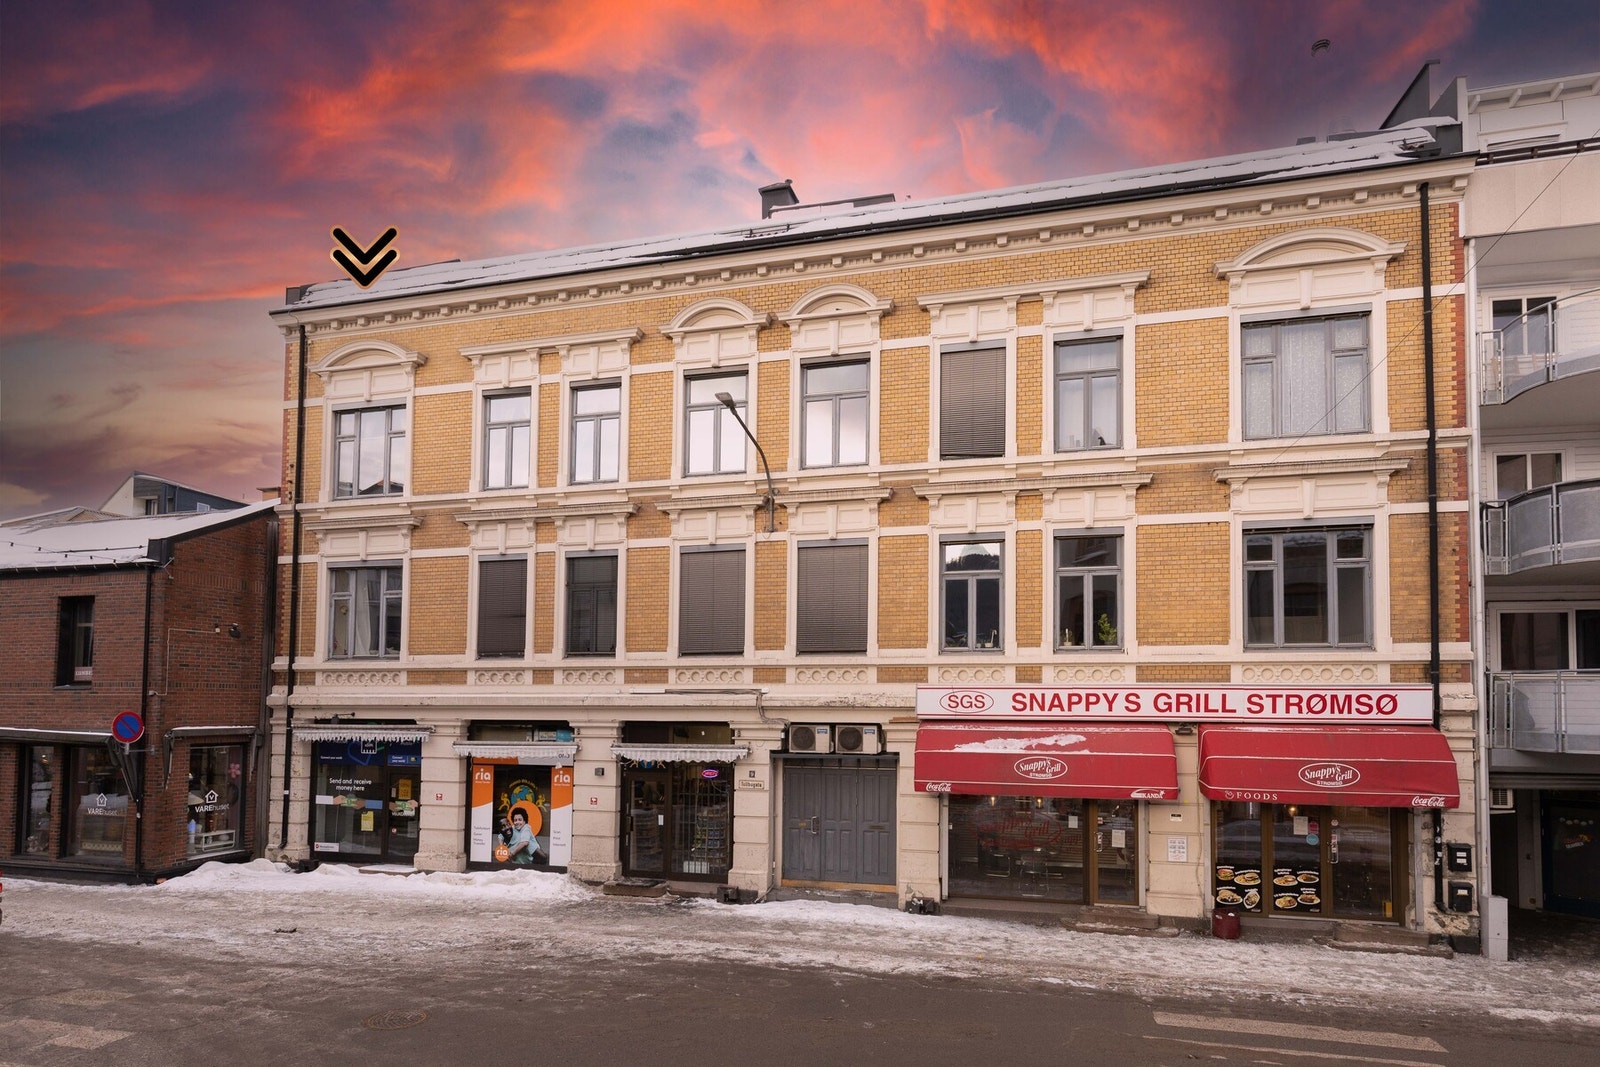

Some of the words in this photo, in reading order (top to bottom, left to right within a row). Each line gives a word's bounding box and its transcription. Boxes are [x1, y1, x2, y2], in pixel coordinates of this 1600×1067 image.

[947, 694, 986, 709] SGS
[1153, 692, 1237, 713] GRILL
[1246, 693, 1399, 715] STRØMSØ
[475, 768, 491, 781] ria
[554, 771, 571, 783] ria
[1335, 770, 1353, 781] Grill
[194, 803, 230, 813] VAREhuset
[496, 847, 508, 856] ria
